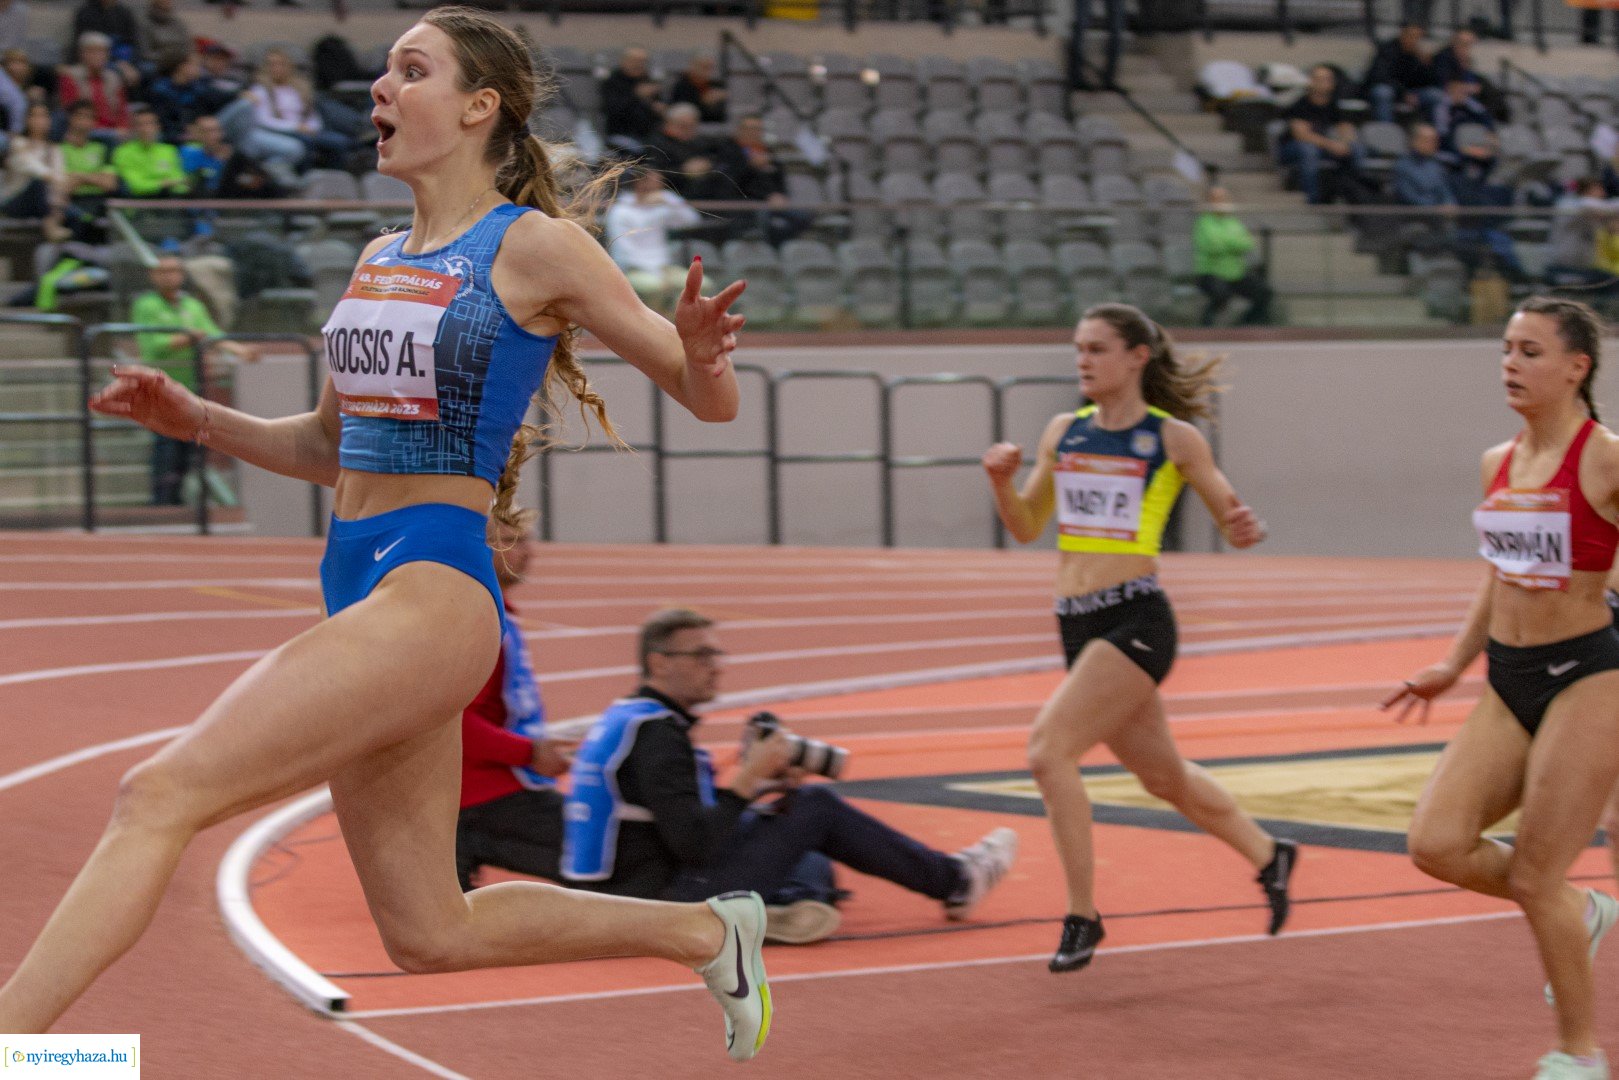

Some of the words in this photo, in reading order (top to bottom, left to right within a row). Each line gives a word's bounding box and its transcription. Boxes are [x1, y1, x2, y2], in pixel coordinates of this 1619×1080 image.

[326, 328, 392, 375] KOCSIS
[396, 331, 426, 378] A.
[390, 403, 420, 415] 2023
[1070, 586, 1123, 616] NIKE
